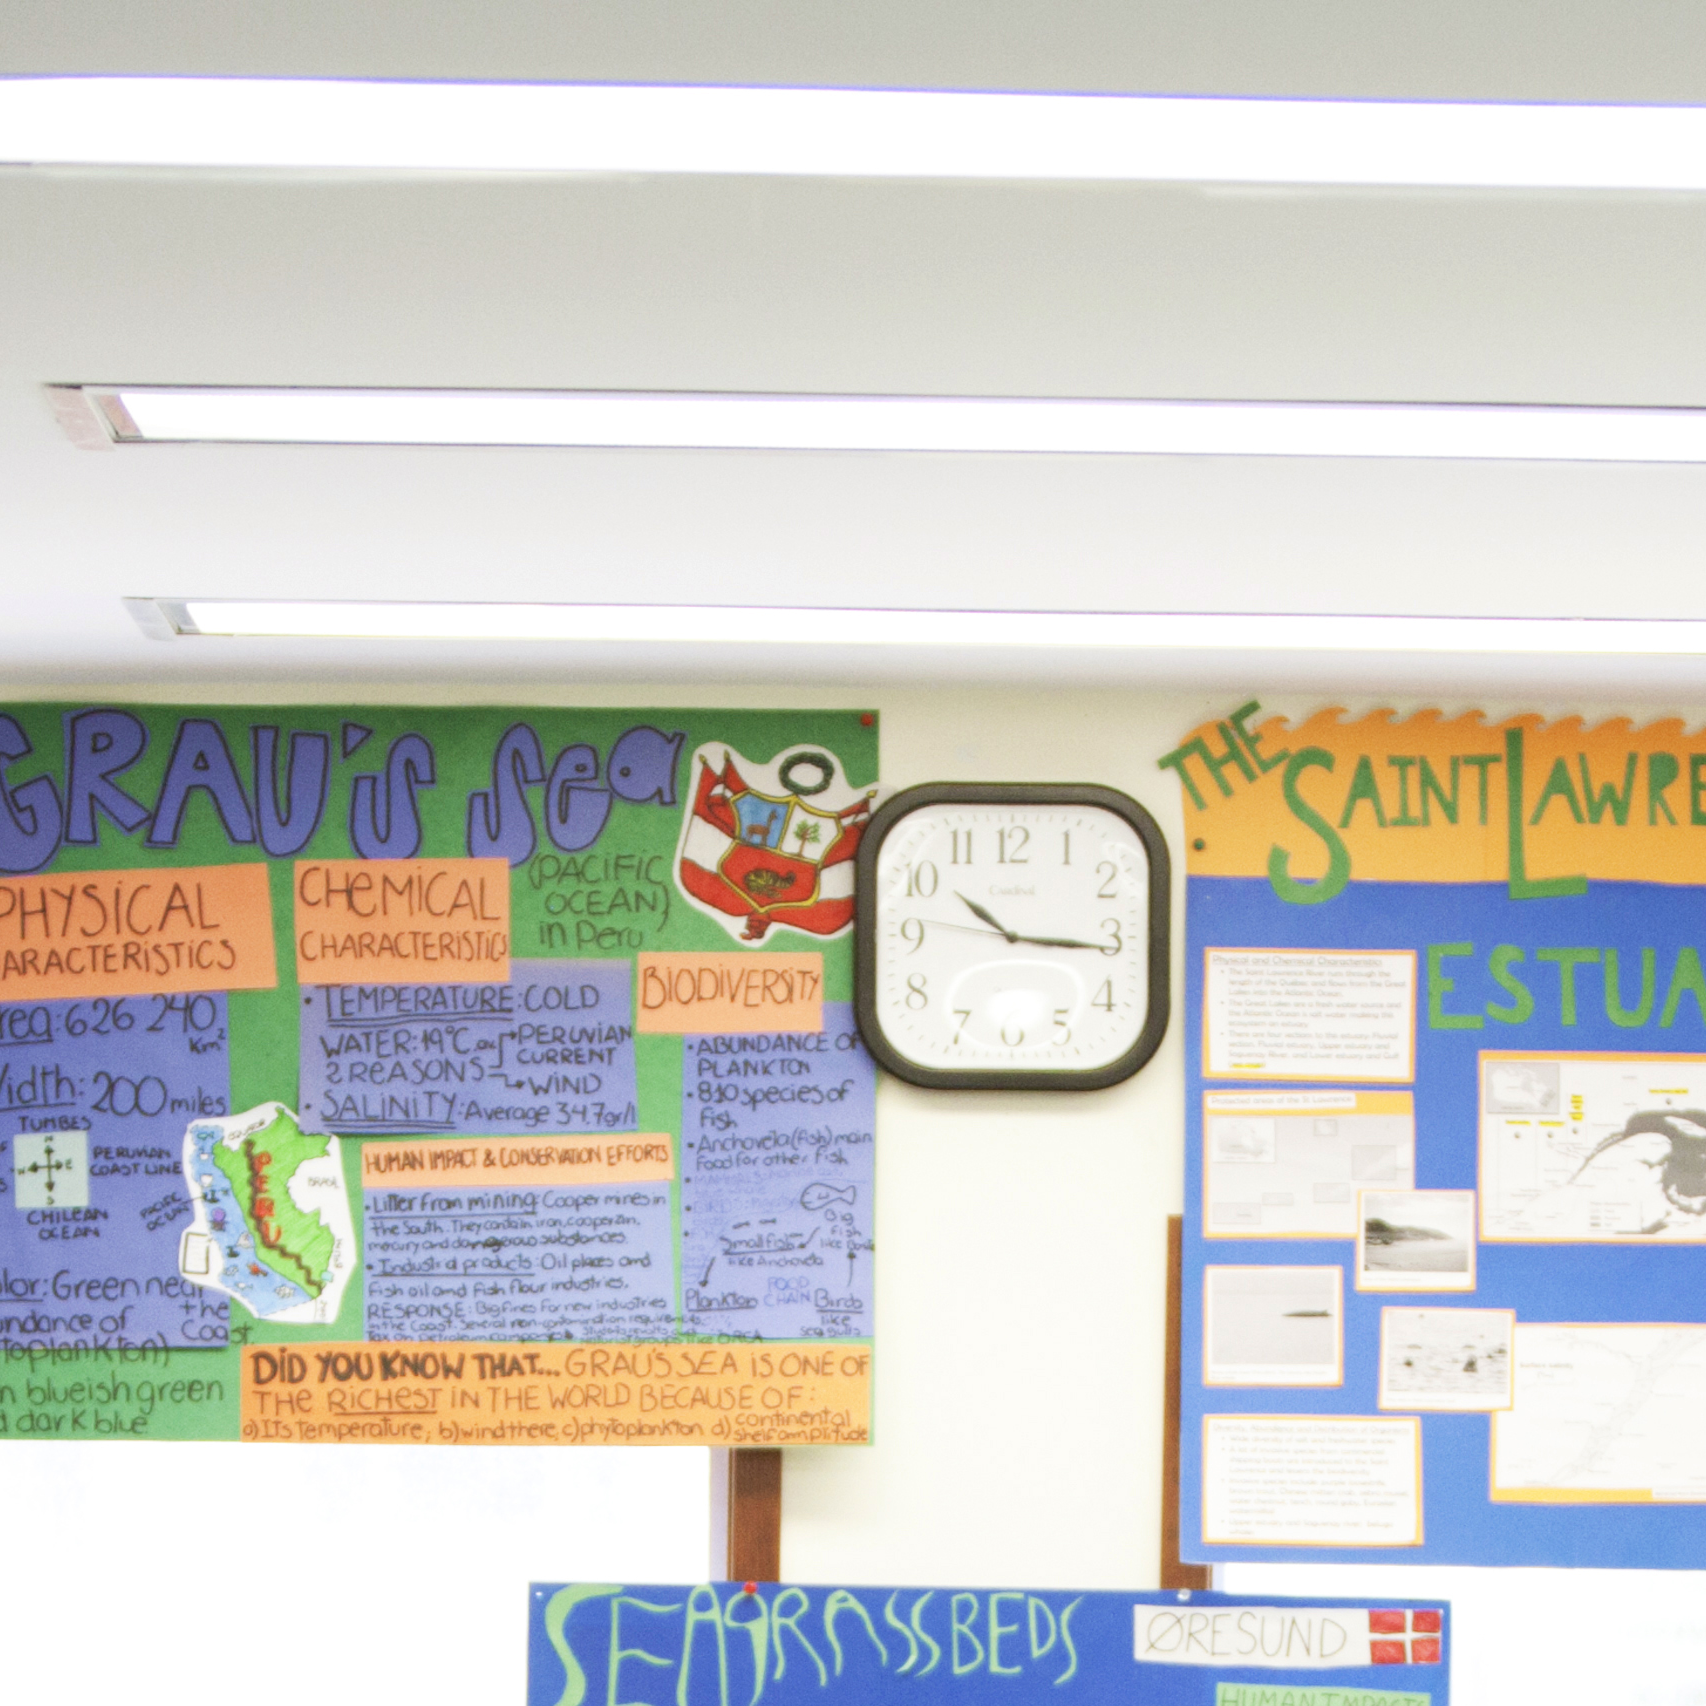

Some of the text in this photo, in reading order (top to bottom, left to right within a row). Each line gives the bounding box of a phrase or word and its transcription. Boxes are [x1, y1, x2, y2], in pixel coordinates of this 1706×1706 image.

[467, 723, 687, 869] Sea
[1159, 700, 1291, 810] THE
[1266, 746, 1502, 906] SAINT
[950, 826, 1071, 865] 11 12 1
[905, 860, 1119, 898] 10 2
[540, 920, 644, 951] in Peru
[901, 917, 1122, 956] 9 3
[524, 984, 599, 1012] COLD
[906, 973, 1116, 1012] 8 4
[64, 1001, 135, 1039] 626
[146, 994, 217, 1033] 240
[953, 1009, 972, 1045] 7
[1052, 1008, 1071, 1046] 5
[517, 1048, 617, 1065] CURRENT
[93, 1072, 168, 1117] 200
[170, 1086, 226, 1116] miles
[528, 1073, 602, 1095] WIND
[465, 1101, 550, 1126] Average
[365, 1142, 669, 1173] HUMAN IMPACT & CONSERVATION EFFORTS
[252, 1347, 307, 1384] DID
[318, 1354, 375, 1382] YOU
[380, 1354, 463, 1380] KNOW
[679, 1349, 737, 1376] SEA
[751, 1352, 773, 1378] IS
[780, 1351, 835, 1377] ONE
[841, 1355, 869, 1377] OF
[1144, 1610, 1348, 1660] ØRESUND
